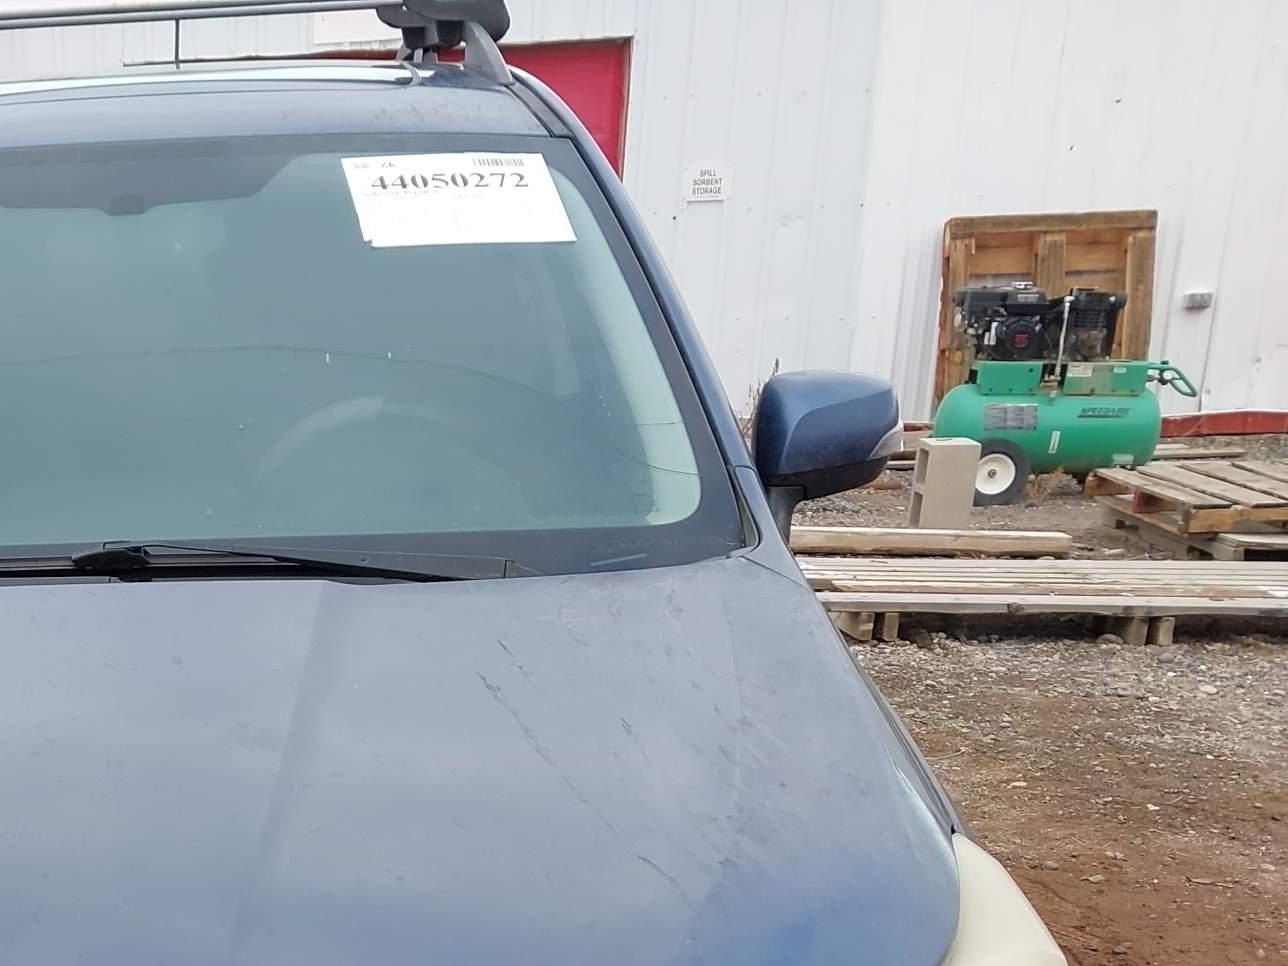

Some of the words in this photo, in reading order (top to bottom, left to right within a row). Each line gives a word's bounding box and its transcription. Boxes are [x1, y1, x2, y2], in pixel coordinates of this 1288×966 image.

[699, 168, 717, 177] SPILL
[370, 172, 529, 191] 44050272
[692, 177, 723, 186] SORBENT
[691, 186, 722, 195] STORAGE
